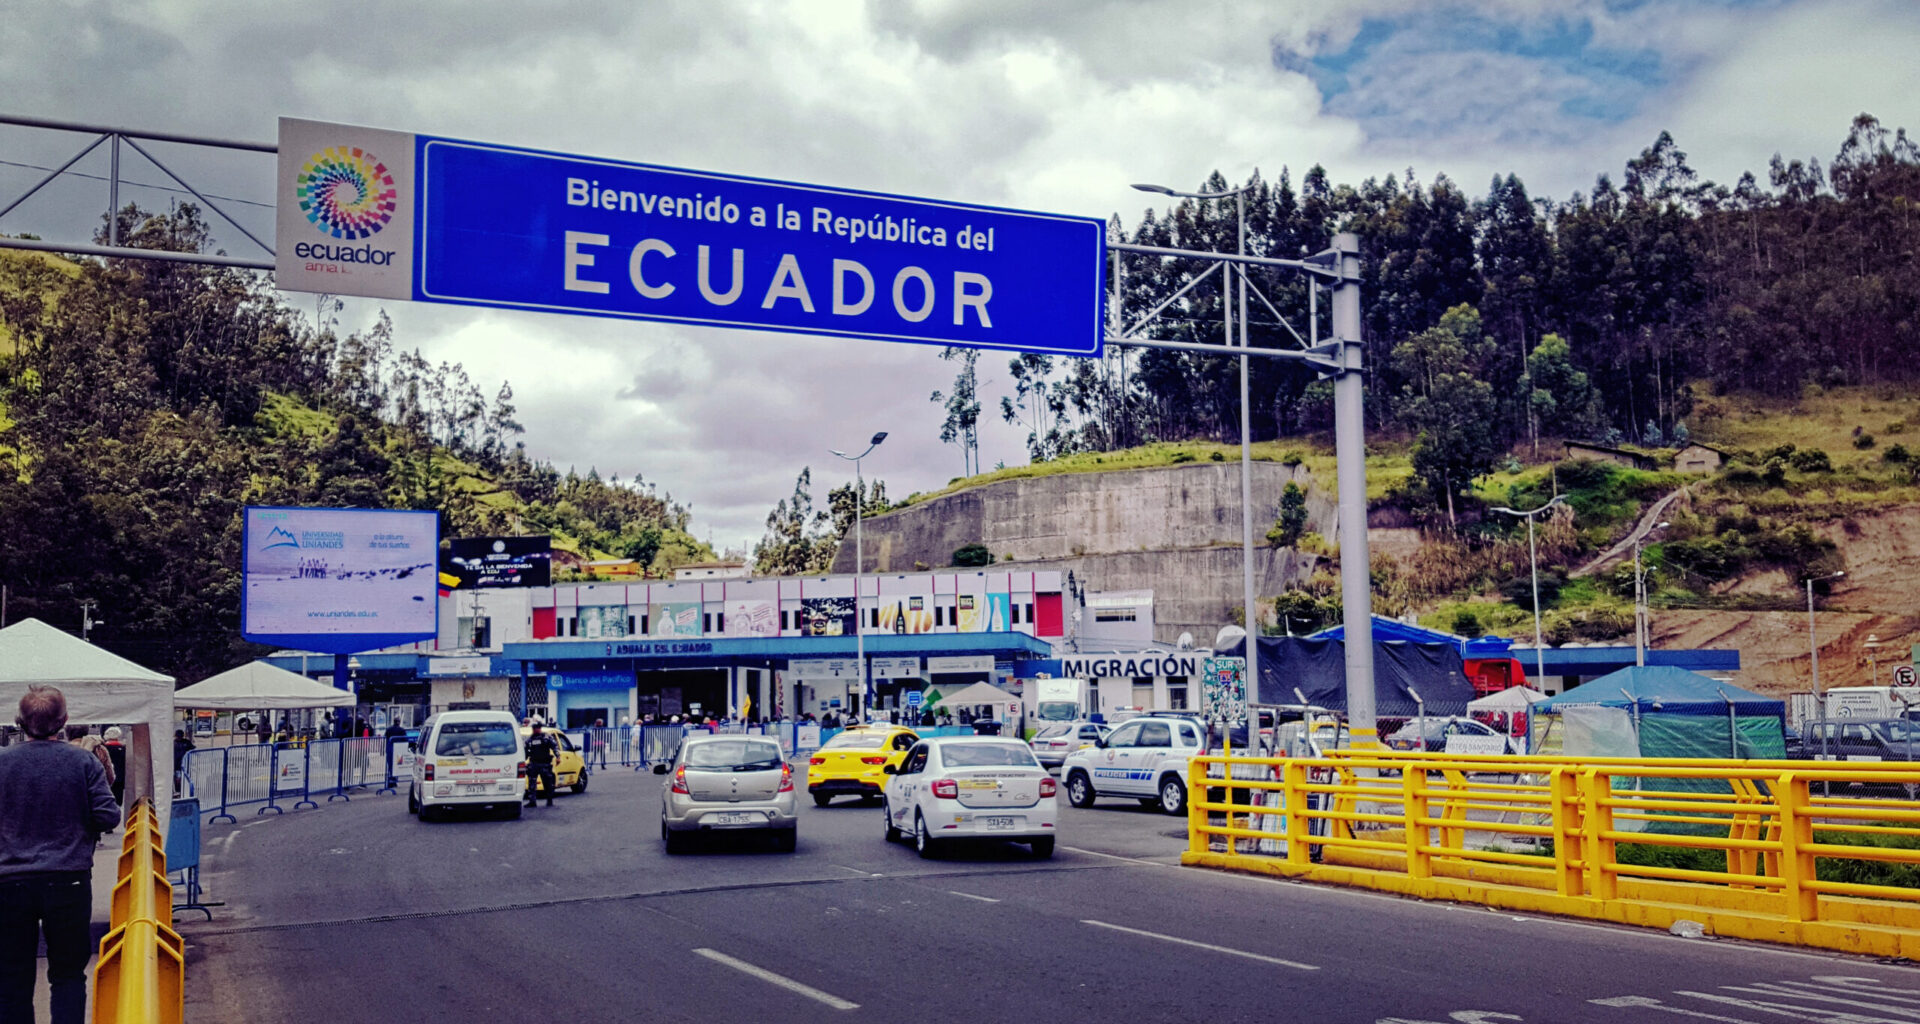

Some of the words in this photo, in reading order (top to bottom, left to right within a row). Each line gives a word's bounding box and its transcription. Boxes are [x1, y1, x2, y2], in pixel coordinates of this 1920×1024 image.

[566, 177, 741, 226] Bienvenido
[749, 205, 767, 227] a
[776, 203, 801, 231] la
[812, 207, 947, 247] República
[956, 227, 995, 252] del
[295, 242, 396, 266] ecuador
[563, 230, 993, 329] ECUADOR
[302, 540, 344, 549] UNIANDES
[1064, 654, 1196, 678] MIGRACIÓN
[1217, 660, 1234, 670] SUR
[565, 676, 588, 684] Banco
